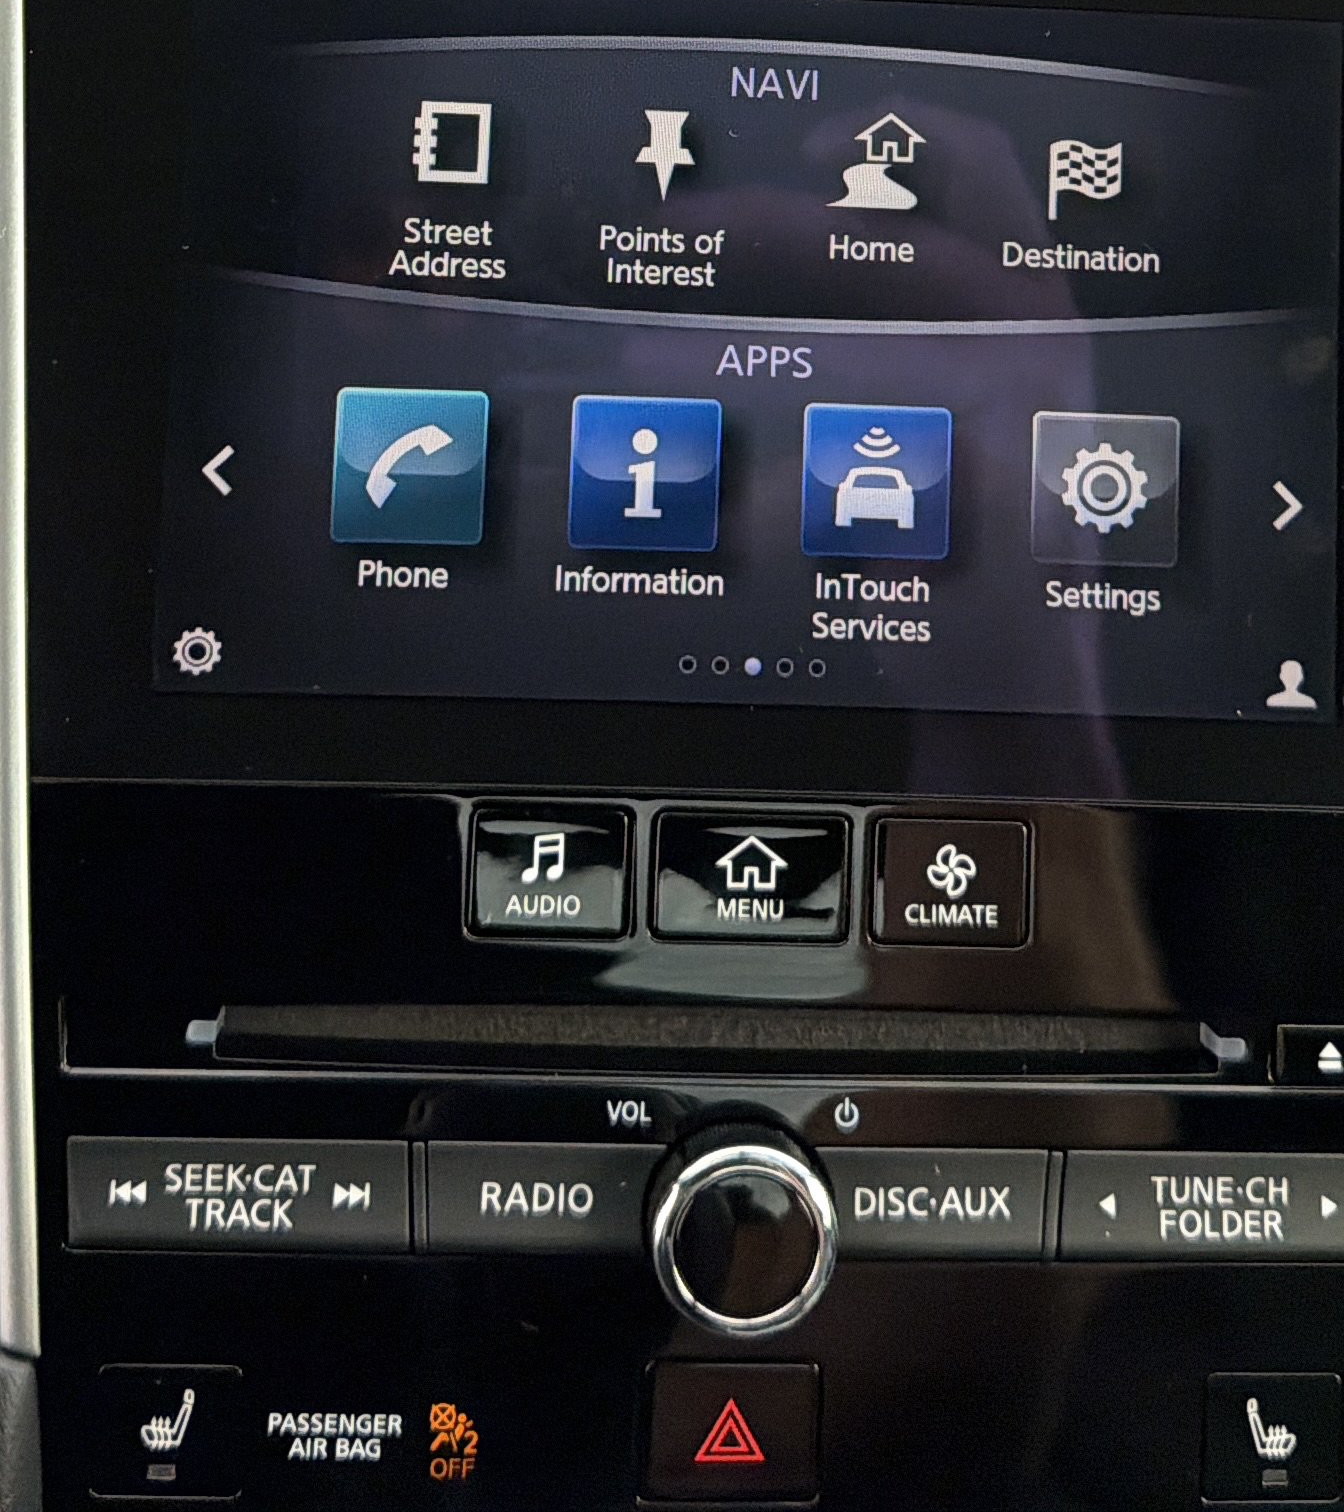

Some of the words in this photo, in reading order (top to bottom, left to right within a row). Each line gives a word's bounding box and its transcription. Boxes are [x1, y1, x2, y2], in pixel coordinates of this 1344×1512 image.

[729, 67, 820, 101] NAVI
[403, 217, 492, 249] Street
[598, 224, 683, 256] Points
[693, 227, 725, 256] of
[828, 234, 916, 264] Home
[388, 249, 506, 281] Address
[605, 256, 716, 288] Interest
[1001, 239, 1160, 273] Destination
[715, 344, 813, 380] APPS
[357, 560, 448, 590] Phone
[554, 566, 724, 597] Information
[814, 572, 931, 605] InTouch
[1045, 580, 1161, 615] Settings
[811, 612, 931, 643] Services
[504, 894, 582, 918] AUDIO
[716, 896, 784, 922] MENU
[904, 900, 998, 929] CLIMATE
[606, 1100, 651, 1126] VOL
[479, 1180, 594, 1216] RADIO
[184, 1196, 294, 1233] TRACK
[1158, 1208, 1284, 1243] FOLDER
[267, 1412, 402, 1437] PASSENGER
[288, 1438, 327, 1461] AIR
[335, 1438, 381, 1461] BAG
[429, 1457, 474, 1480] OFF
